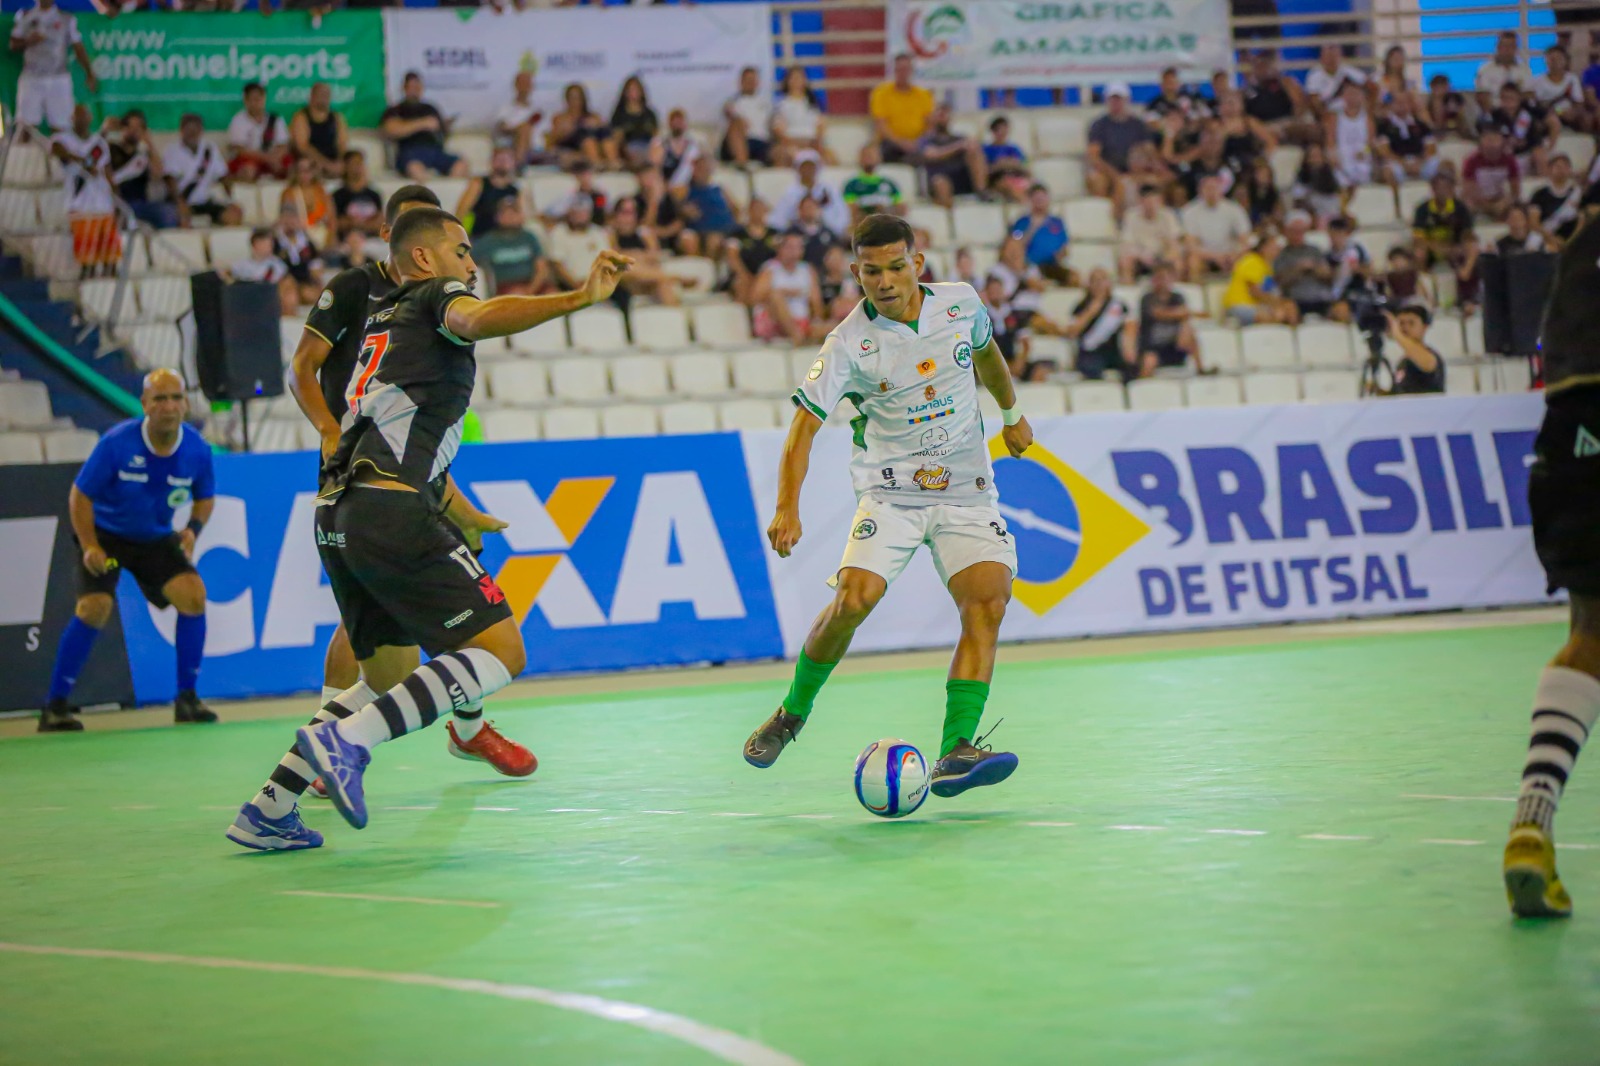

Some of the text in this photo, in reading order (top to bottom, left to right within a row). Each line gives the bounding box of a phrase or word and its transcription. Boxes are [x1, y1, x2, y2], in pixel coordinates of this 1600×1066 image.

[449, 544, 485, 580] 17
[1138, 553, 1429, 617] DE FUTSAL
